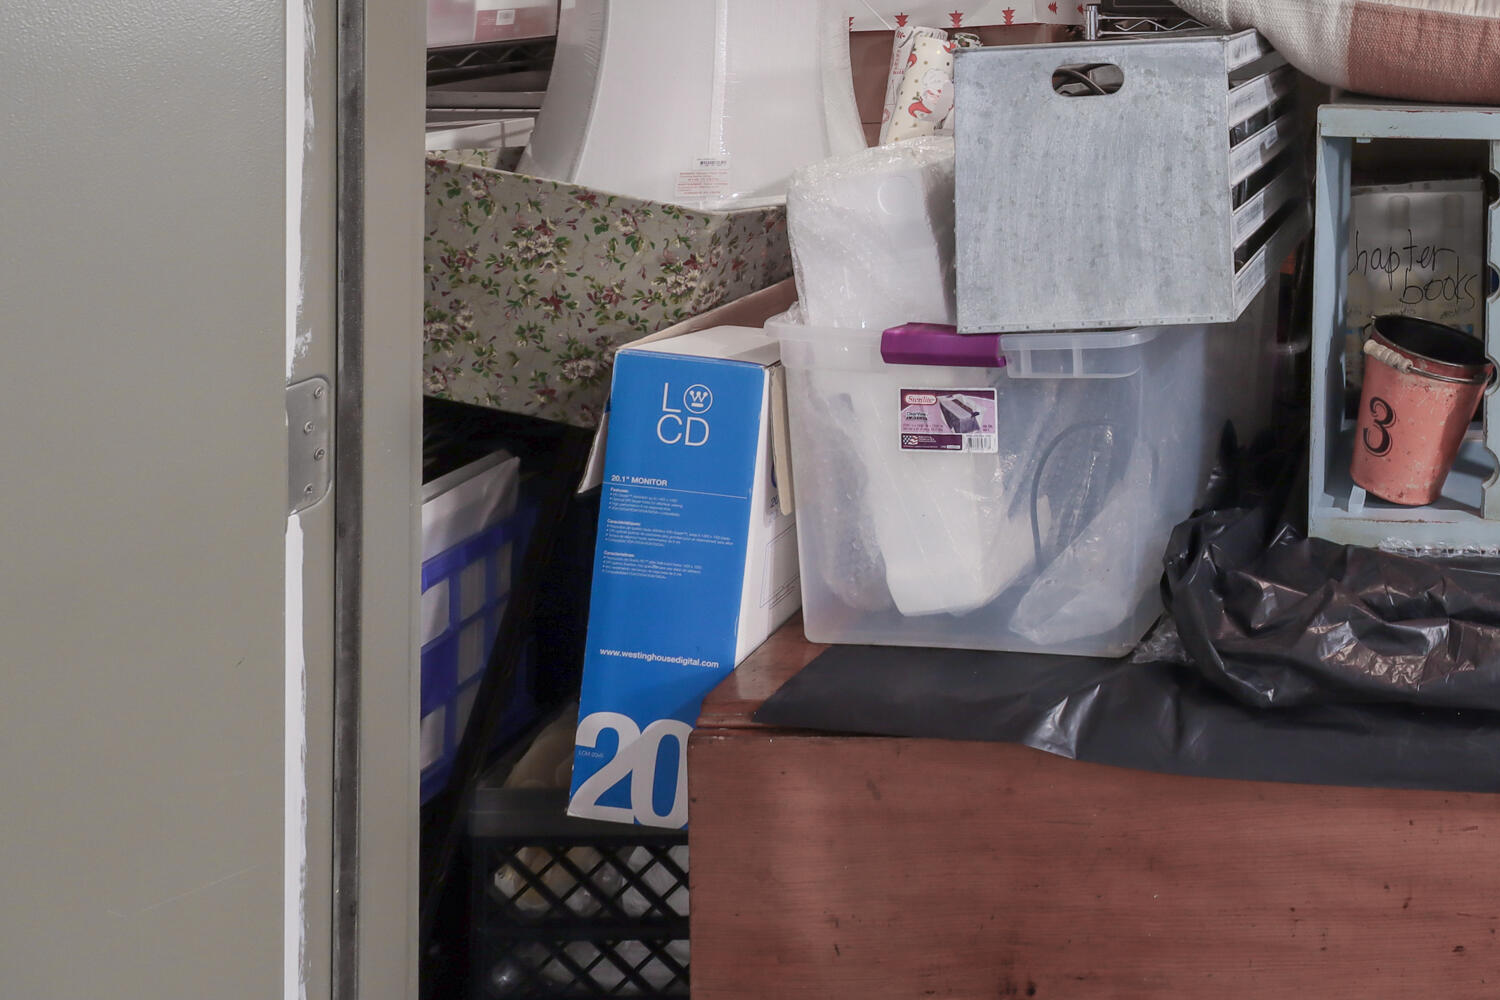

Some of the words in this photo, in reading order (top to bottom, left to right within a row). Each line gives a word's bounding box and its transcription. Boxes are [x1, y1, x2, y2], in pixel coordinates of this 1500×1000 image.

[1348, 228, 1456, 291] hapter
[1363, 396, 1396, 457] 3
[631, 476, 668, 487] MONITOR
[599, 648, 720, 669] www.westinghousedigital.com
[566, 711, 691, 830] 20
